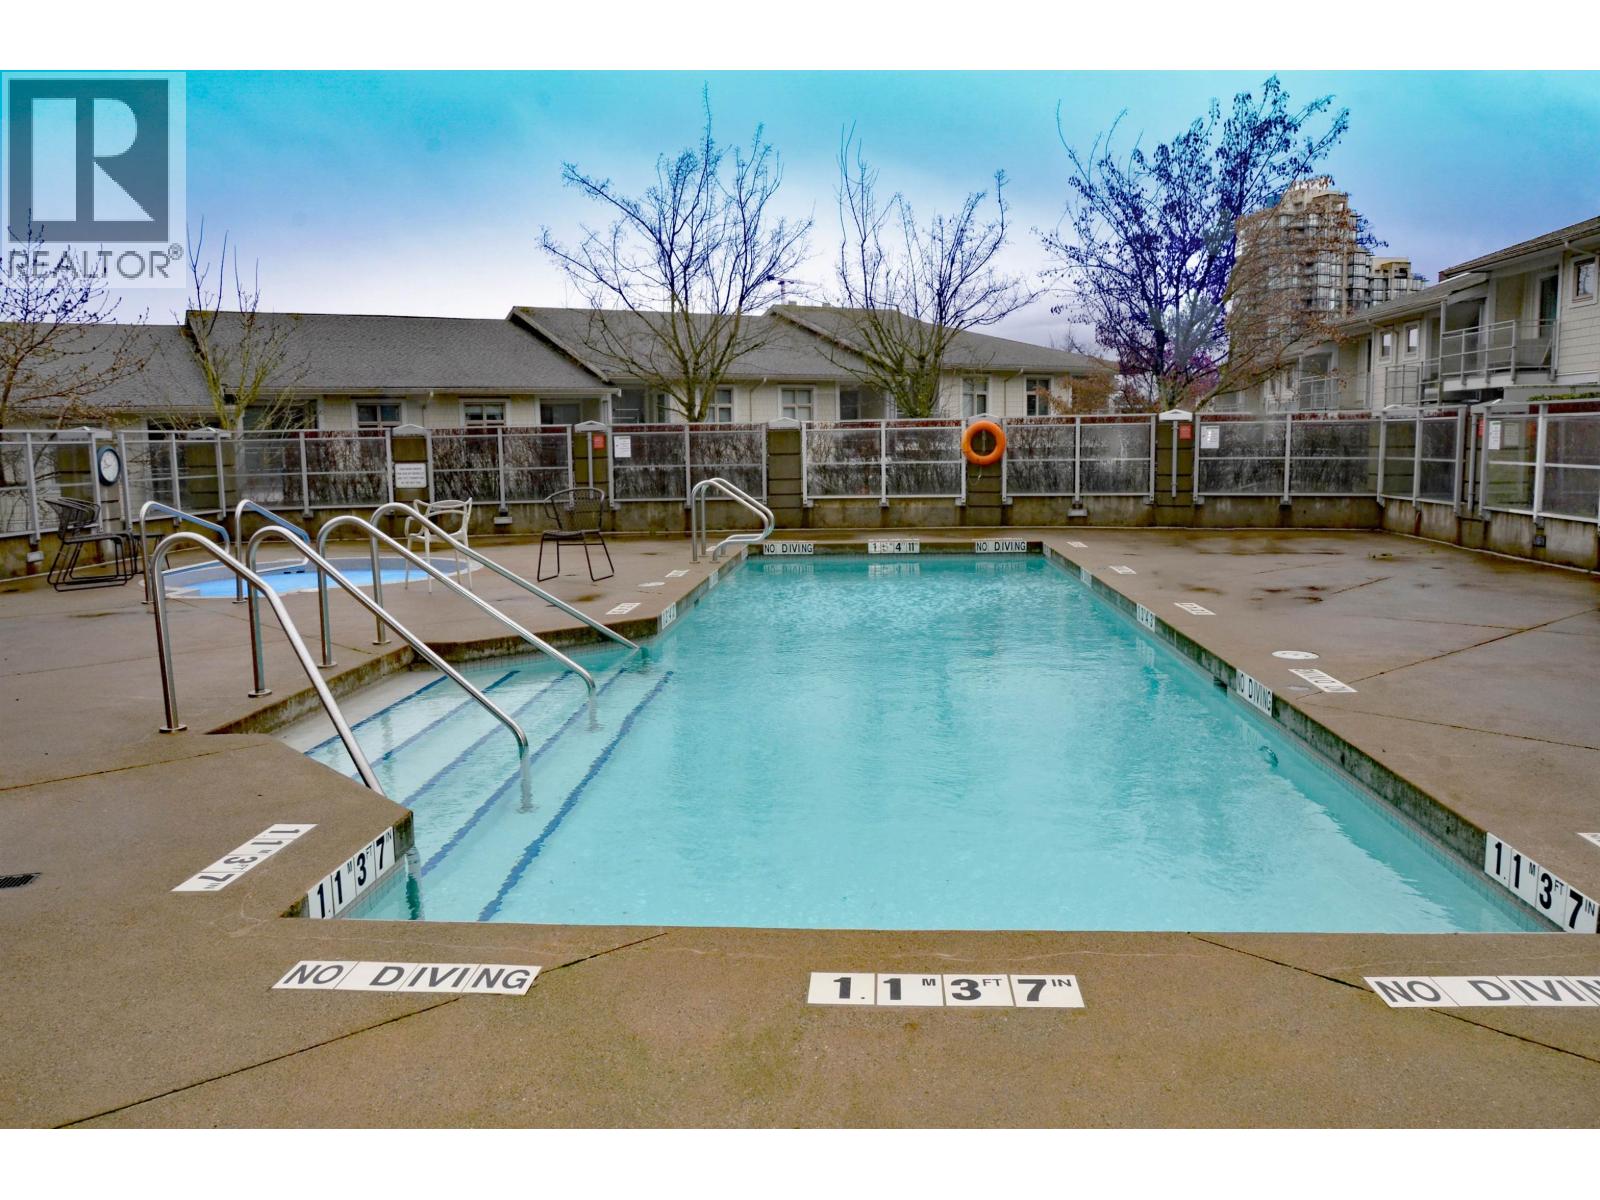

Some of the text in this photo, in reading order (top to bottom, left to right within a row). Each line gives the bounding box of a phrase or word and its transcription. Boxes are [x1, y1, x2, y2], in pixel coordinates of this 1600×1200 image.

[764, 543, 813, 553] NO DIVING
[976, 541, 1026, 552] NO DIVING
[356, 852, 367, 887] 3
[375, 835, 385, 871] 7
[1539, 872, 1553, 910] 3
[1569, 889, 1583, 929] 7
[283, 964, 531, 990] NO DIVING
[921, 978, 937, 988] M
[950, 978, 983, 1001] 3
[982, 978, 1003, 988] FT
[1016, 978, 1048, 1002] 7
[1052, 978, 1073, 988] IN
[1374, 980, 1442, 1003] NO
